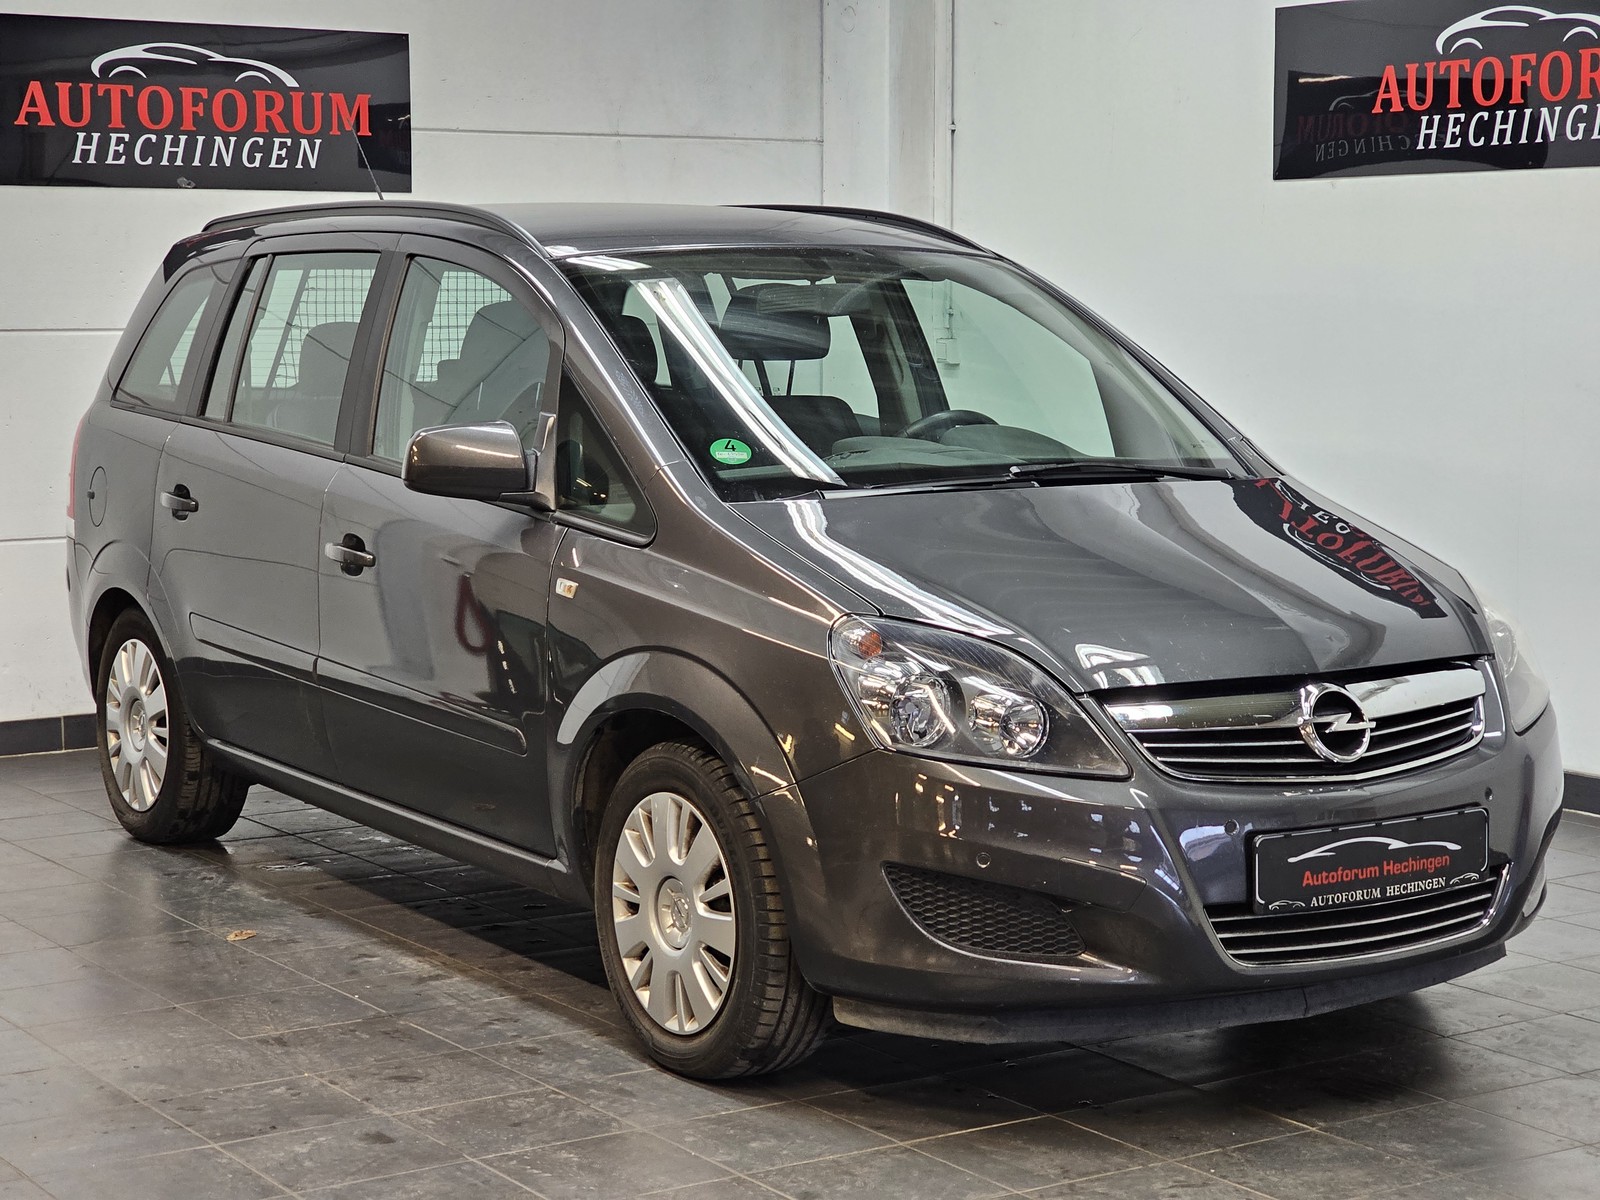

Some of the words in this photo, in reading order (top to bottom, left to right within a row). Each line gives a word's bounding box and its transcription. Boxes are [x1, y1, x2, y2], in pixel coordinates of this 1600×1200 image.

[1372, 47, 1600, 113] AUTOFOR
[14, 80, 371, 136] AUTOFORUM
[72, 132, 322, 169] HECHINGEN
[724, 439, 737, 452] 4
[1302, 865, 1380, 887] Autoforum
[1383, 855, 1450, 876] Hechingen
[1310, 888, 1381, 908] AUTOFORUM
[1386, 877, 1447, 897] HECHINGEN
